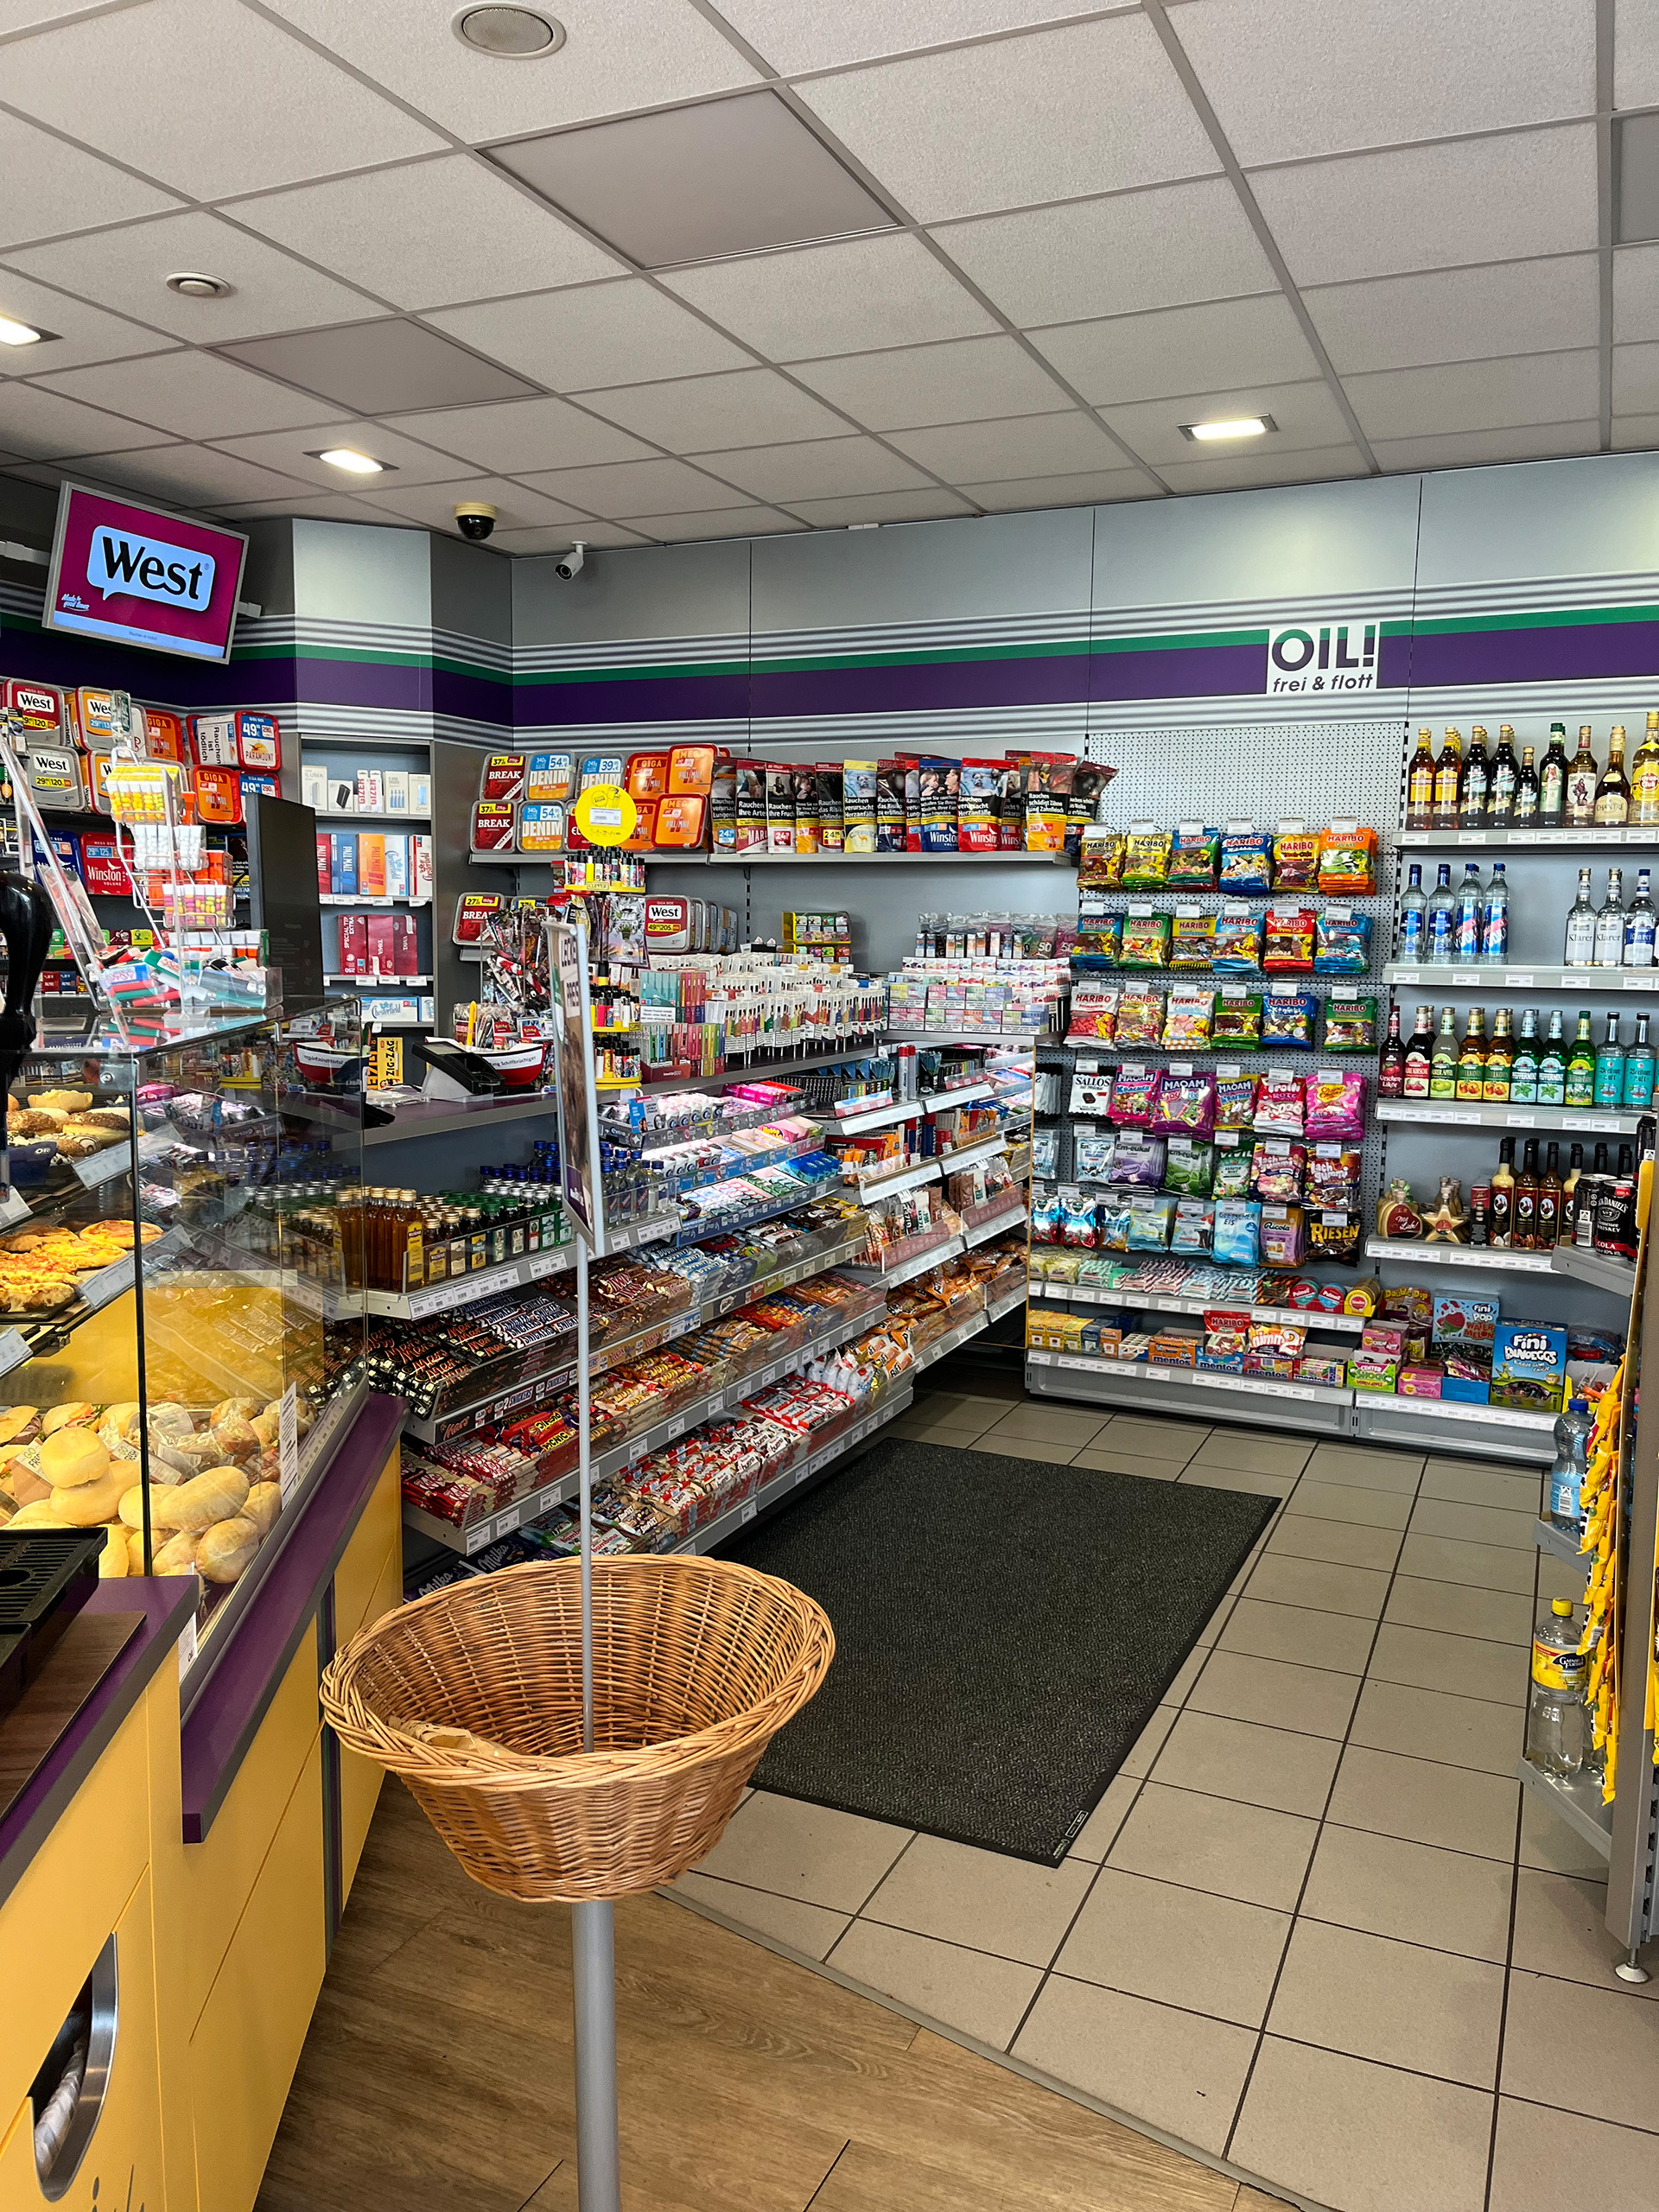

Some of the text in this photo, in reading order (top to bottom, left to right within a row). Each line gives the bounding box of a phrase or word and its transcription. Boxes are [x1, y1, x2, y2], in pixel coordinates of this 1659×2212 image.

[102, 536, 203, 600] West
[1271, 625, 1376, 671] OIL!
[1273, 673, 1374, 693] frei & flott
[20, 694, 52, 710] West
[90, 701, 111, 713] Wes
[245, 750, 274, 762] PARAMOUNT
[35, 756, 67, 771] West
[601, 760, 613, 771] 39
[641, 760, 663, 768] GIGA
[203, 772, 224, 783] GIGA
[488, 771, 522, 779] BREAK
[529, 769, 569, 786] DENIM
[478, 819, 511, 828] BREAK
[522, 821, 563, 837] DENIM
[1179, 836, 1211, 844] HARIBO
[1225, 837, 1263, 847] HARIBO
[1280, 841, 1313, 851] HARIBO
[86, 864, 122, 882] Winston
[651, 906, 679, 918] West
[1082, 917, 1115, 925] HARIBO
[1129, 919, 1162, 929] HARIBO
[1221, 917, 1258, 926] HARIBO
[1274, 918, 1306, 928] HARIBO
[1324, 918, 1357, 927] HARIBO
[1567, 933, 1592, 942] Klarer
[1597, 933, 1622, 942] Klarer
[1075, 994, 1111, 1003] HARIBO
[1222, 999, 1255, 1007] HARIBO
[1268, 997, 1307, 1007] HARIBO
[372, 1003, 401, 1020] Chesterfield
[1332, 1003, 1366, 1013] HARIBO
[385, 1040, 395, 1077] ZIG-ZAG
[1075, 1077, 1111, 1087] SALLOS
[1117, 1072, 1156, 1082] MAOAM
[1164, 1079, 1205, 1090] MAOAM
[1217, 1080, 1252, 1092] MAOAM
[1116, 1143, 1151, 1153] Em-eukal
[1263, 1221, 1291, 1231] Ricola
[1309, 1222, 1360, 1243] RIESEN
[1597, 1241, 1616, 1249] COLA
[1384, 1287, 1428, 1300] Double Dip
[1211, 1318, 1244, 1327] HARIBO
[1472, 1313, 1493, 1321] POP
[1466, 1321, 1494, 1332] WATER
[1464, 1329, 1495, 1339] MELON
[413, 1351, 449, 1372] Mars
[1153, 1355, 1192, 1366] mentos
[889, 1363, 901, 1378] BiFi
[1199, 1361, 1238, 1372] mentos
[1248, 1368, 1288, 1379] mentos
[547, 1372, 569, 1391] SNICKERS
[509, 1386, 534, 1408] SNICKERS
[443, 1416, 470, 1440] Mars
[736, 1427, 750, 1438] bueno
[541, 1431, 569, 1452] PICNIC
[757, 1434, 769, 1447] bueno
[770, 1436, 784, 1452] bueno
[22, 1446, 37, 1459] GO
[741, 1456, 755, 1471] bueno
[634, 1471, 649, 1485] bueno
[673, 1491, 686, 1503] bueno
[478, 1542, 510, 1571] Milka
